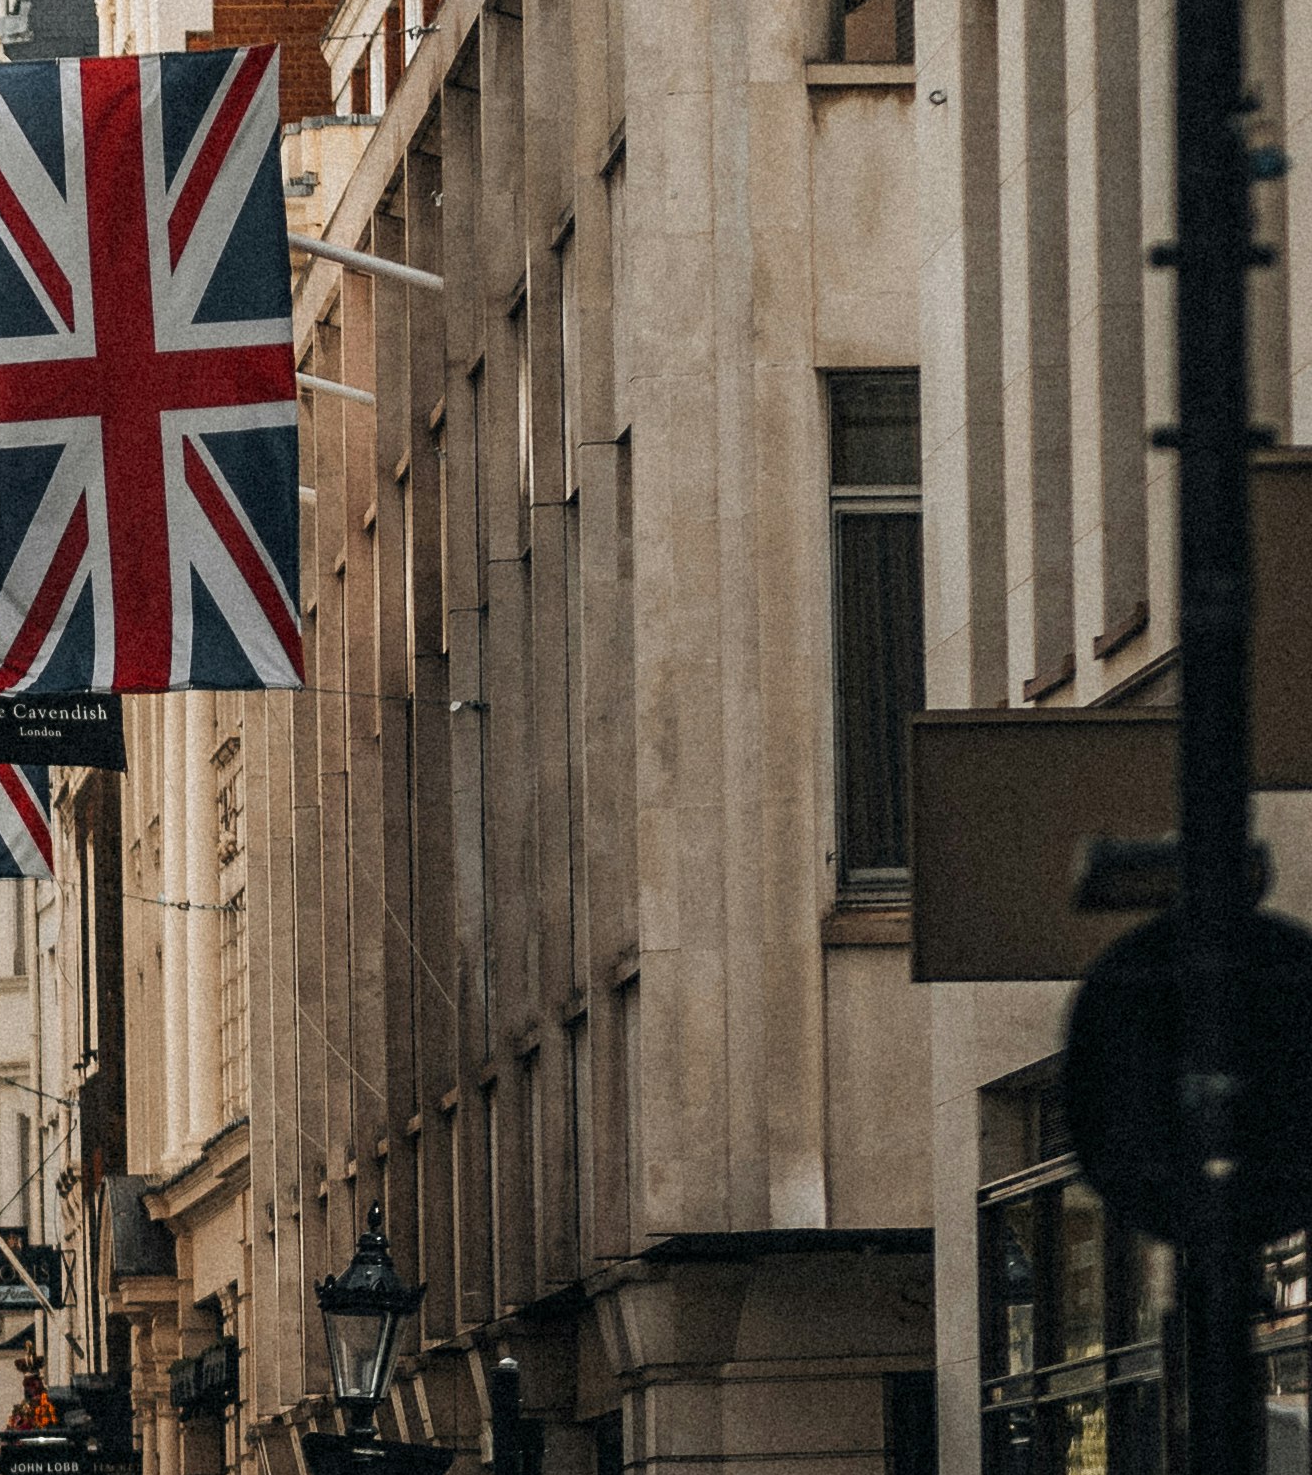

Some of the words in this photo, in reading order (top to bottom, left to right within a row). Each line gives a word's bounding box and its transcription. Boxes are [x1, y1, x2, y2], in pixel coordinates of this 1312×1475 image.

[13, 703, 108, 720] Cavendish
[19, 726, 62, 737] London
[10, 1462, 43, 1473] JOHN
[47, 1462, 79, 1472] LOBB
